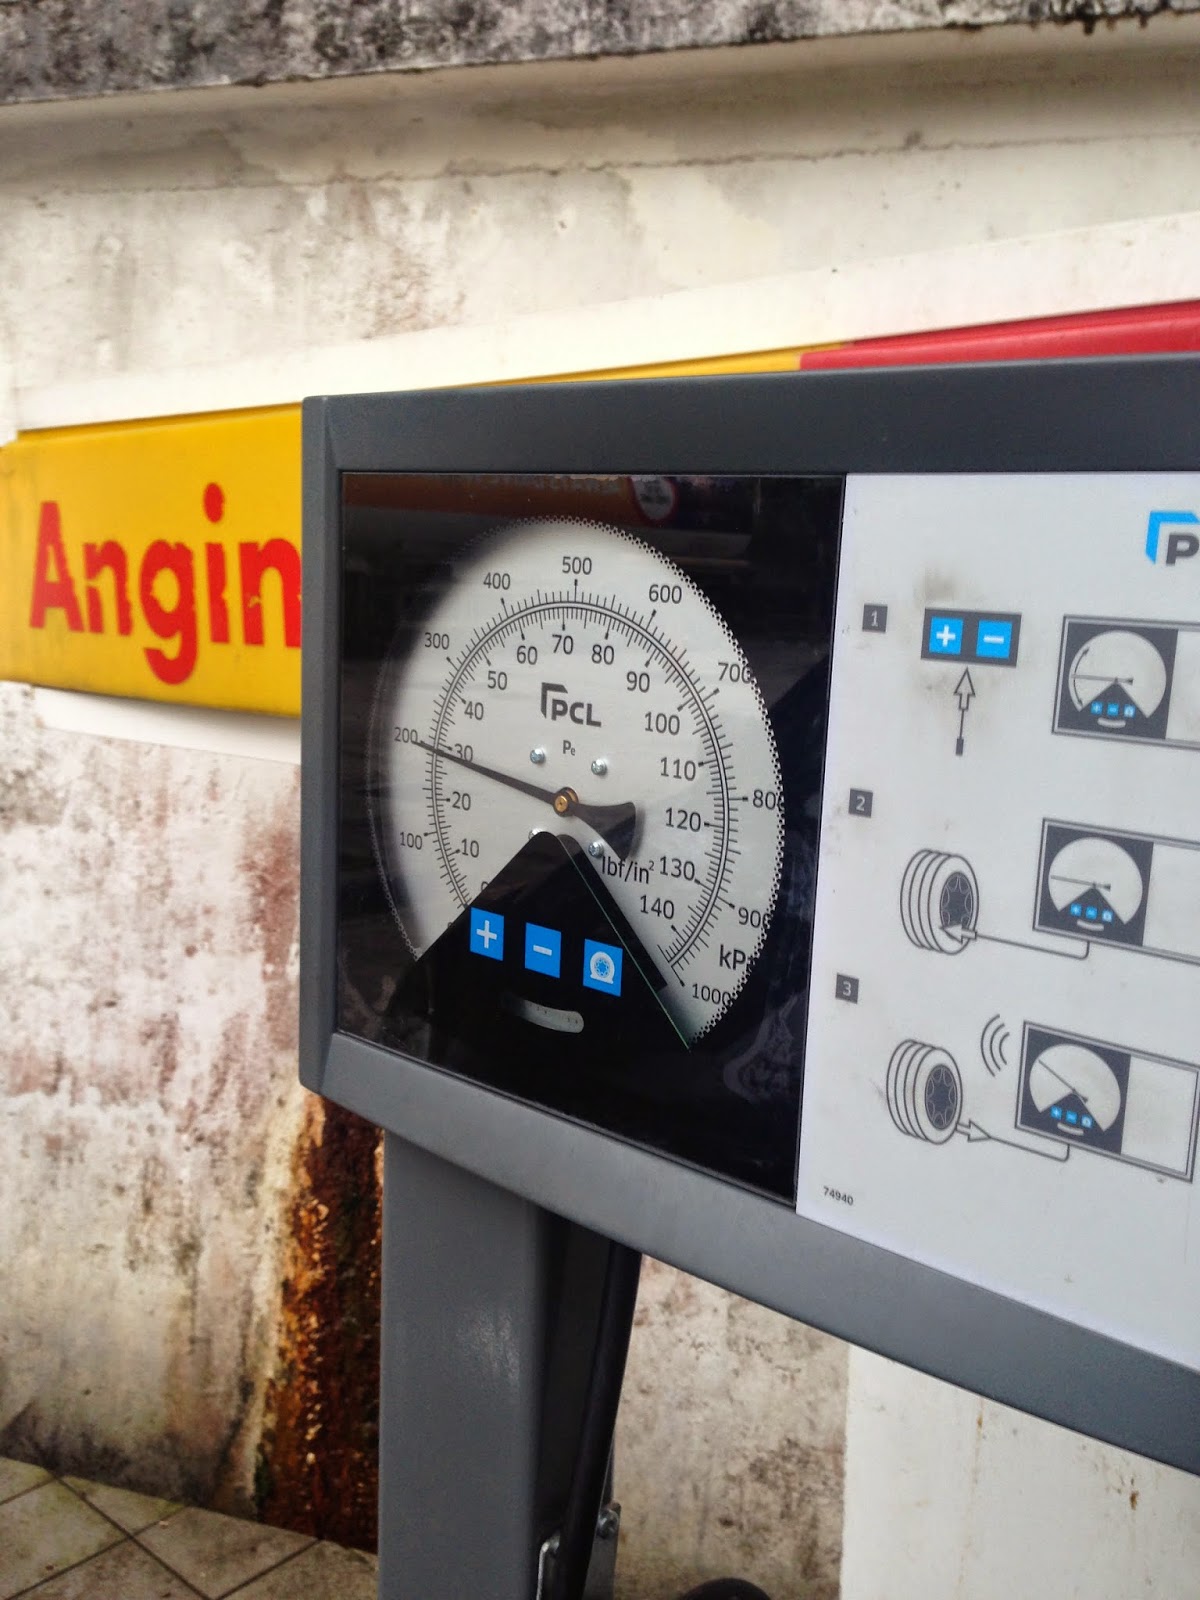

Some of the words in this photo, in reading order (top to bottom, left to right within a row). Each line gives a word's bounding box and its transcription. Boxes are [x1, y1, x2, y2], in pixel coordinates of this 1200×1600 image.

[562, 556, 592, 575] 500
[483, 572, 511, 590] 400
[649, 584, 682, 604] 600
[870, 611, 880, 628] 1
[424, 632, 450, 650] 300
[552, 634, 574, 655] 70
[516, 645, 538, 665] 60
[591, 644, 615, 665] 80
[487, 670, 508, 690] 50
[626, 671, 650, 693] 90
[464, 701, 484, 721] 40
[551, 698, 602, 728] PCL
[644, 711, 681, 735] 100
[394, 727, 418, 744] 200
[454, 743, 474, 762] 30
[660, 757, 696, 782] 110
[452, 791, 472, 811] 20
[855, 796, 866, 812] 2
[665, 807, 701, 833] 120
[400, 832, 423, 850] 100
[461, 838, 480, 858] 10
[660, 855, 696, 882] 130
[640, 894, 675, 920] 140
[842, 981, 852, 997] 3
[823, 1185, 854, 1206] 74940
